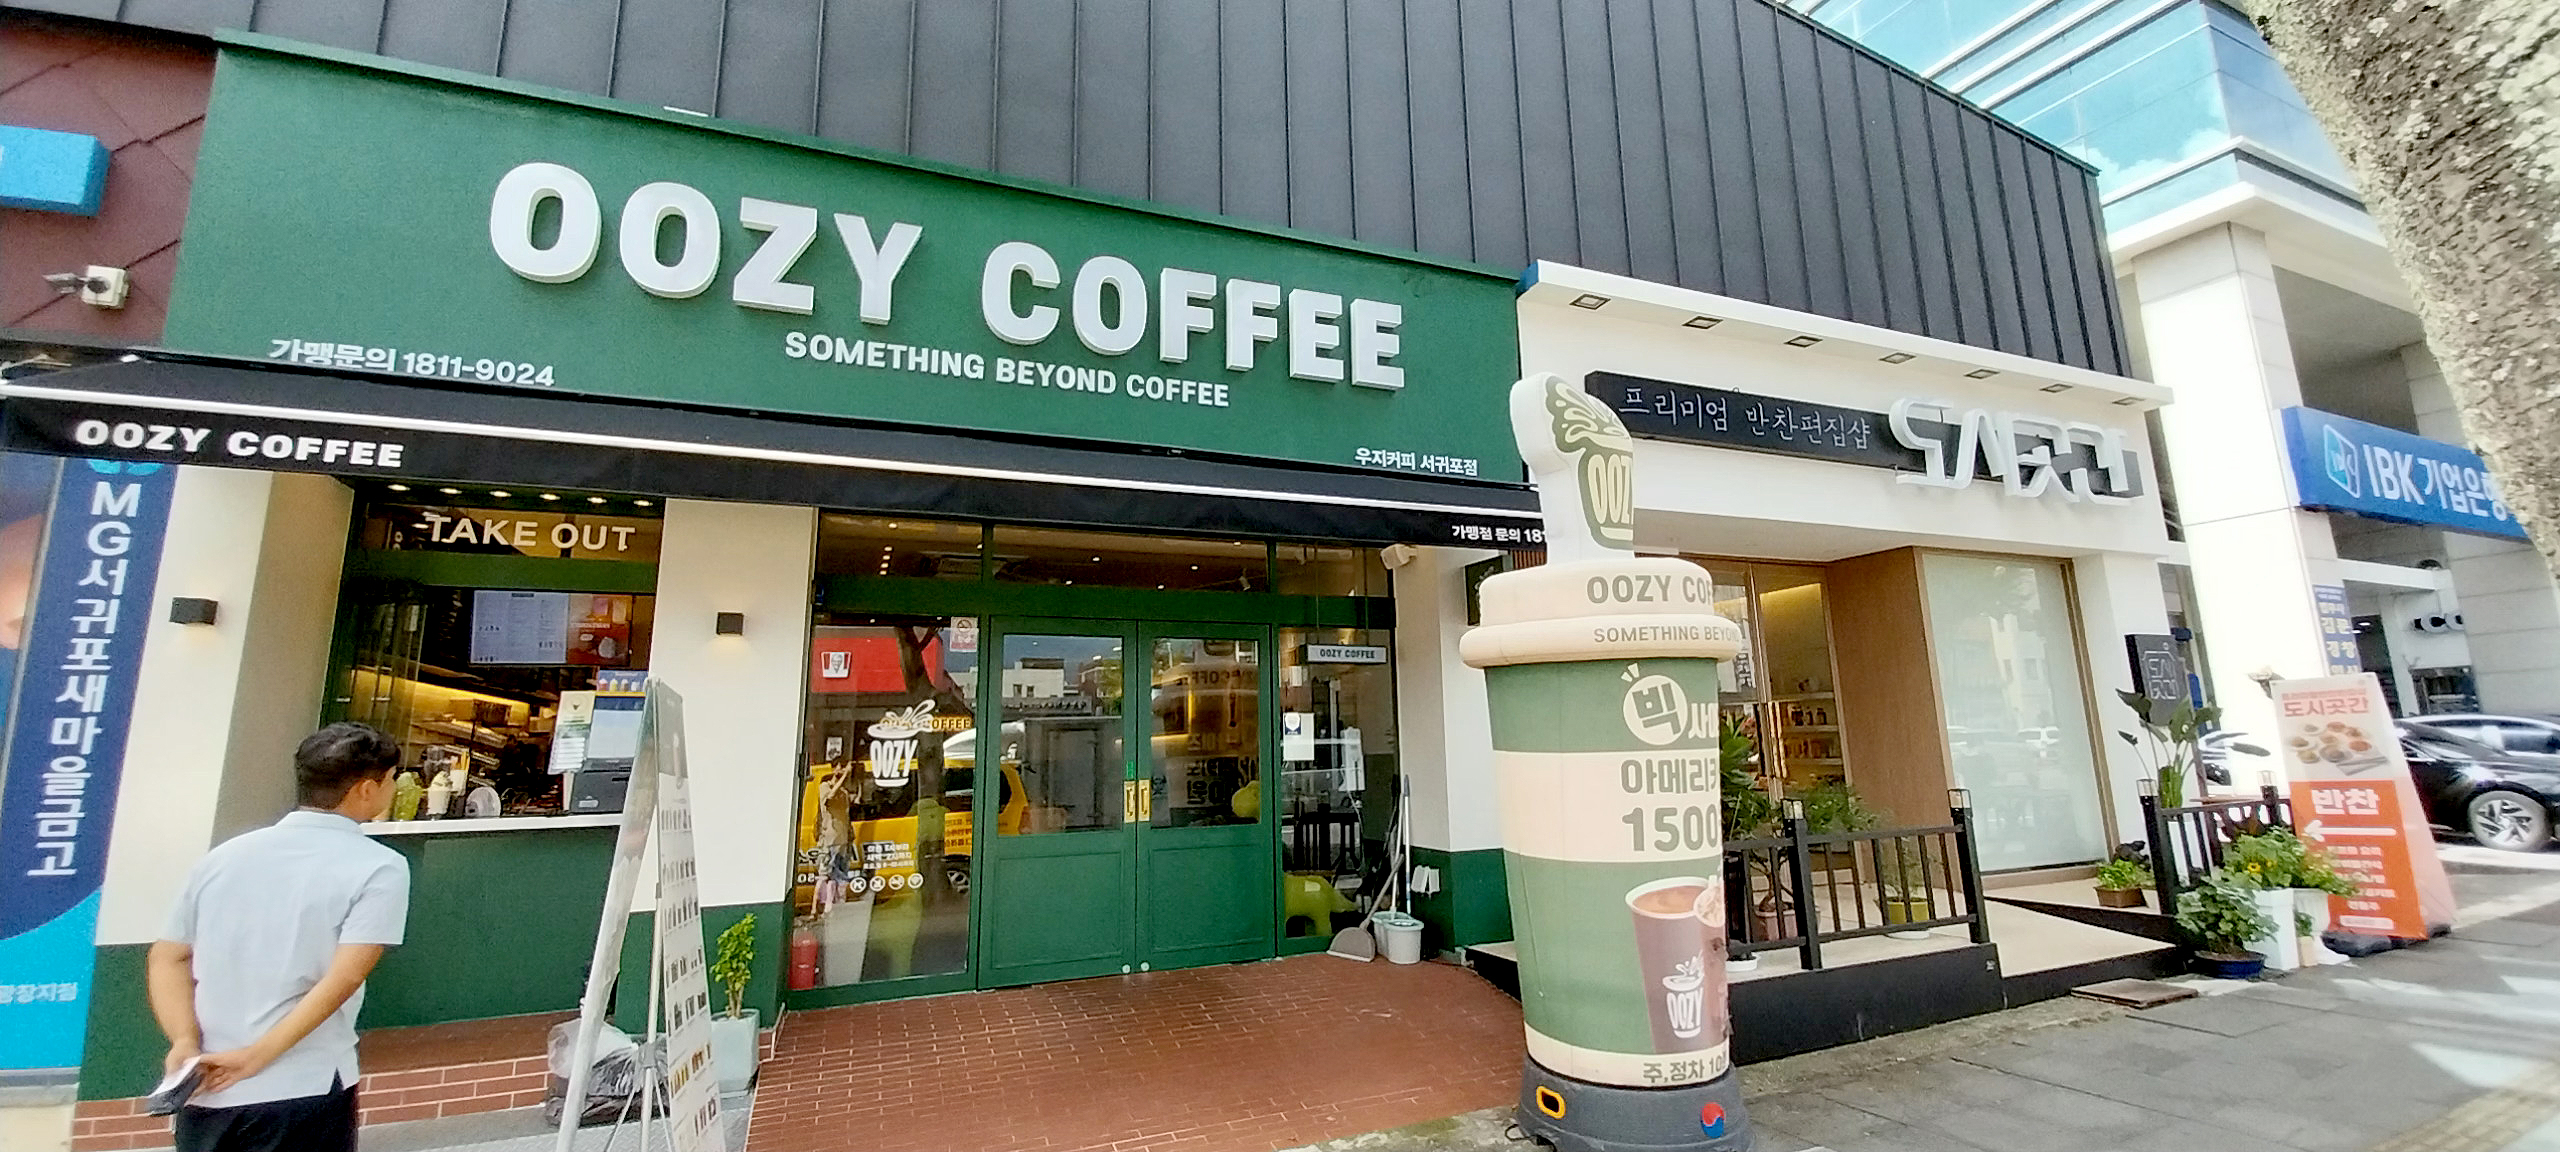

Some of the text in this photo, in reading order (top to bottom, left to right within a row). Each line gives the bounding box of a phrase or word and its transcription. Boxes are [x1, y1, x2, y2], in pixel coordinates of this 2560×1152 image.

[490, 162, 1405, 392] OOZY COFFEE
[269, 338, 555, 387] 가맹문의 1811-9024
[785, 331, 1230, 407] SOMETHING BEYOND COFFEE
[1619, 387, 1871, 451] 프리미엄 반찬편집샵
[75, 419, 405, 469] OOZY COFFEE
[1355, 447, 1478, 476] 우지커피 서귀포점
[1587, 453, 1634, 525] OOZ
[425, 516, 636, 551] TAKE OUT
[1452, 525, 1546, 543] 가맹점 문의 18
[1586, 575, 1671, 604] OOZY
[1319, 648, 1376, 660] OOZY COFFEE
[1594, 626, 1699, 643] SOMETHING
[871, 739, 919, 779] OOZY
[2311, 788, 2380, 815] 반찬
[1622, 803, 1718, 852] 1500
[1666, 987, 1703, 1030] OOZY
